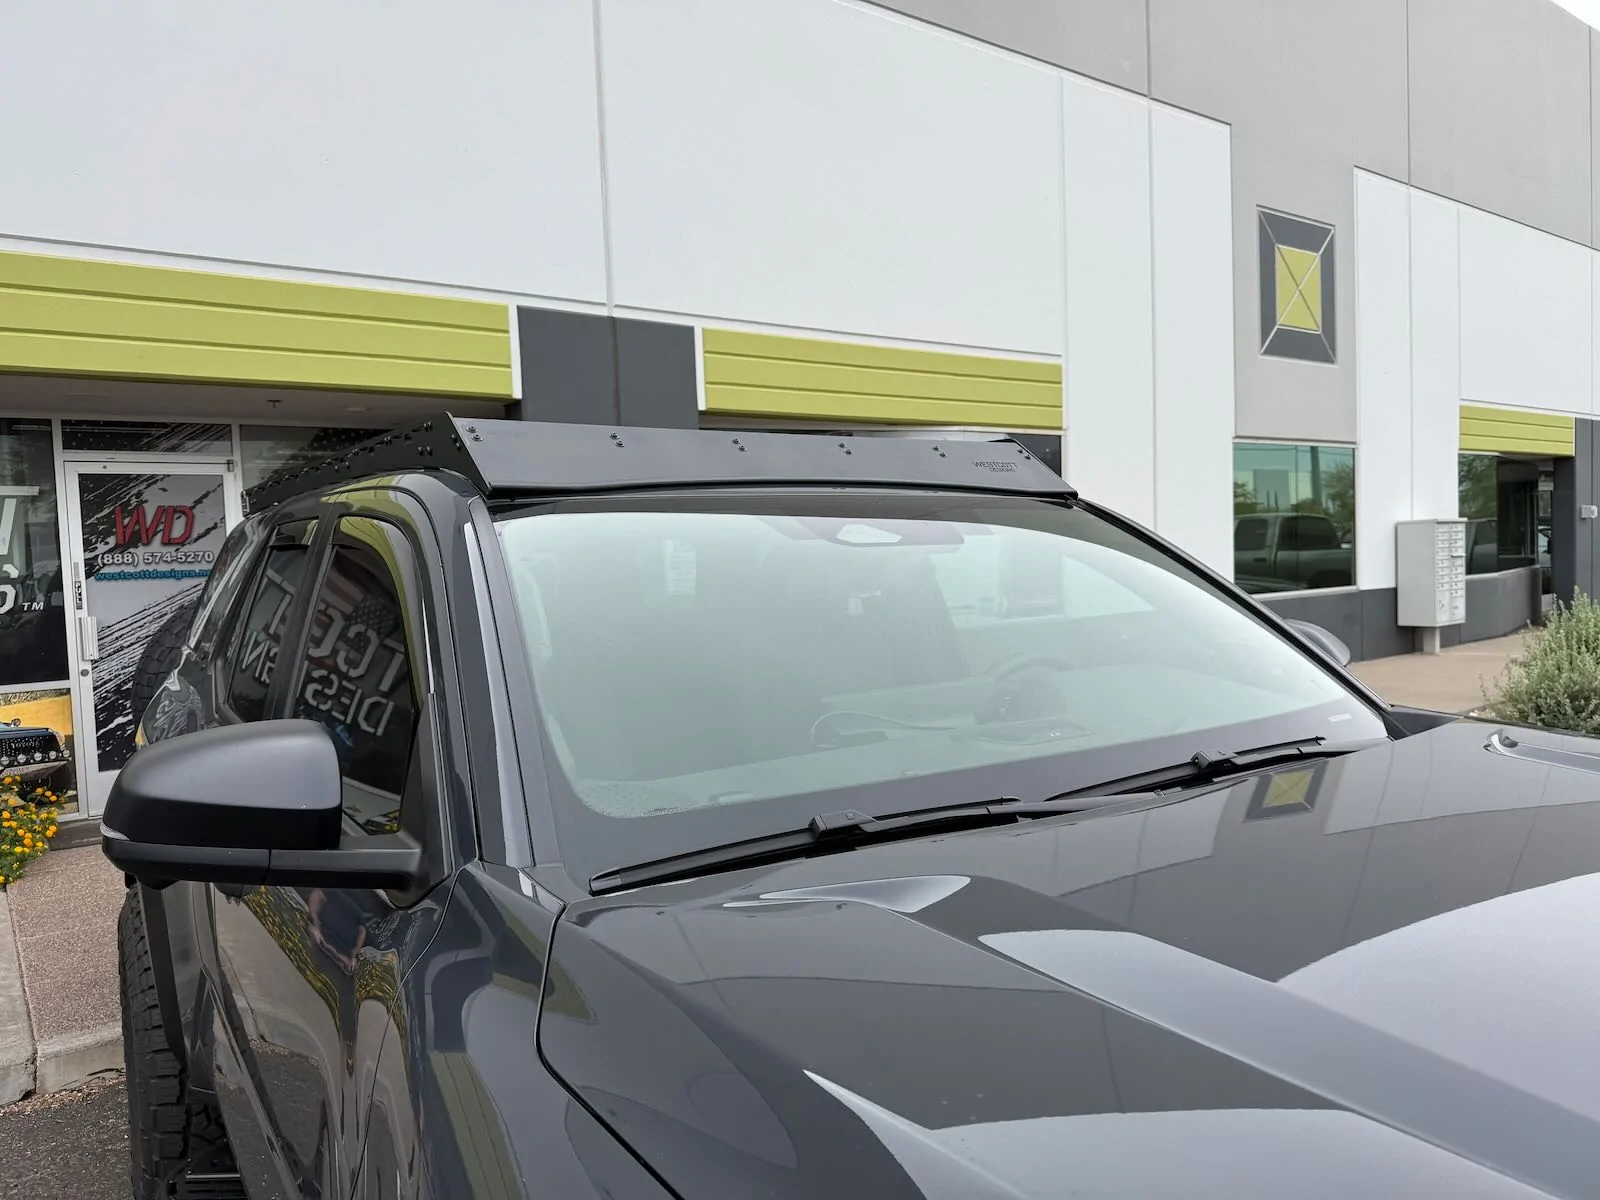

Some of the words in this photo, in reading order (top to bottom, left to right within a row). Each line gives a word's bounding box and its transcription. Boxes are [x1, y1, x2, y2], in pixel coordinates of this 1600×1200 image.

[114, 504, 196, 546] WD
[97, 552, 139, 567] (888)
[143, 551, 214, 565] 574-5270
